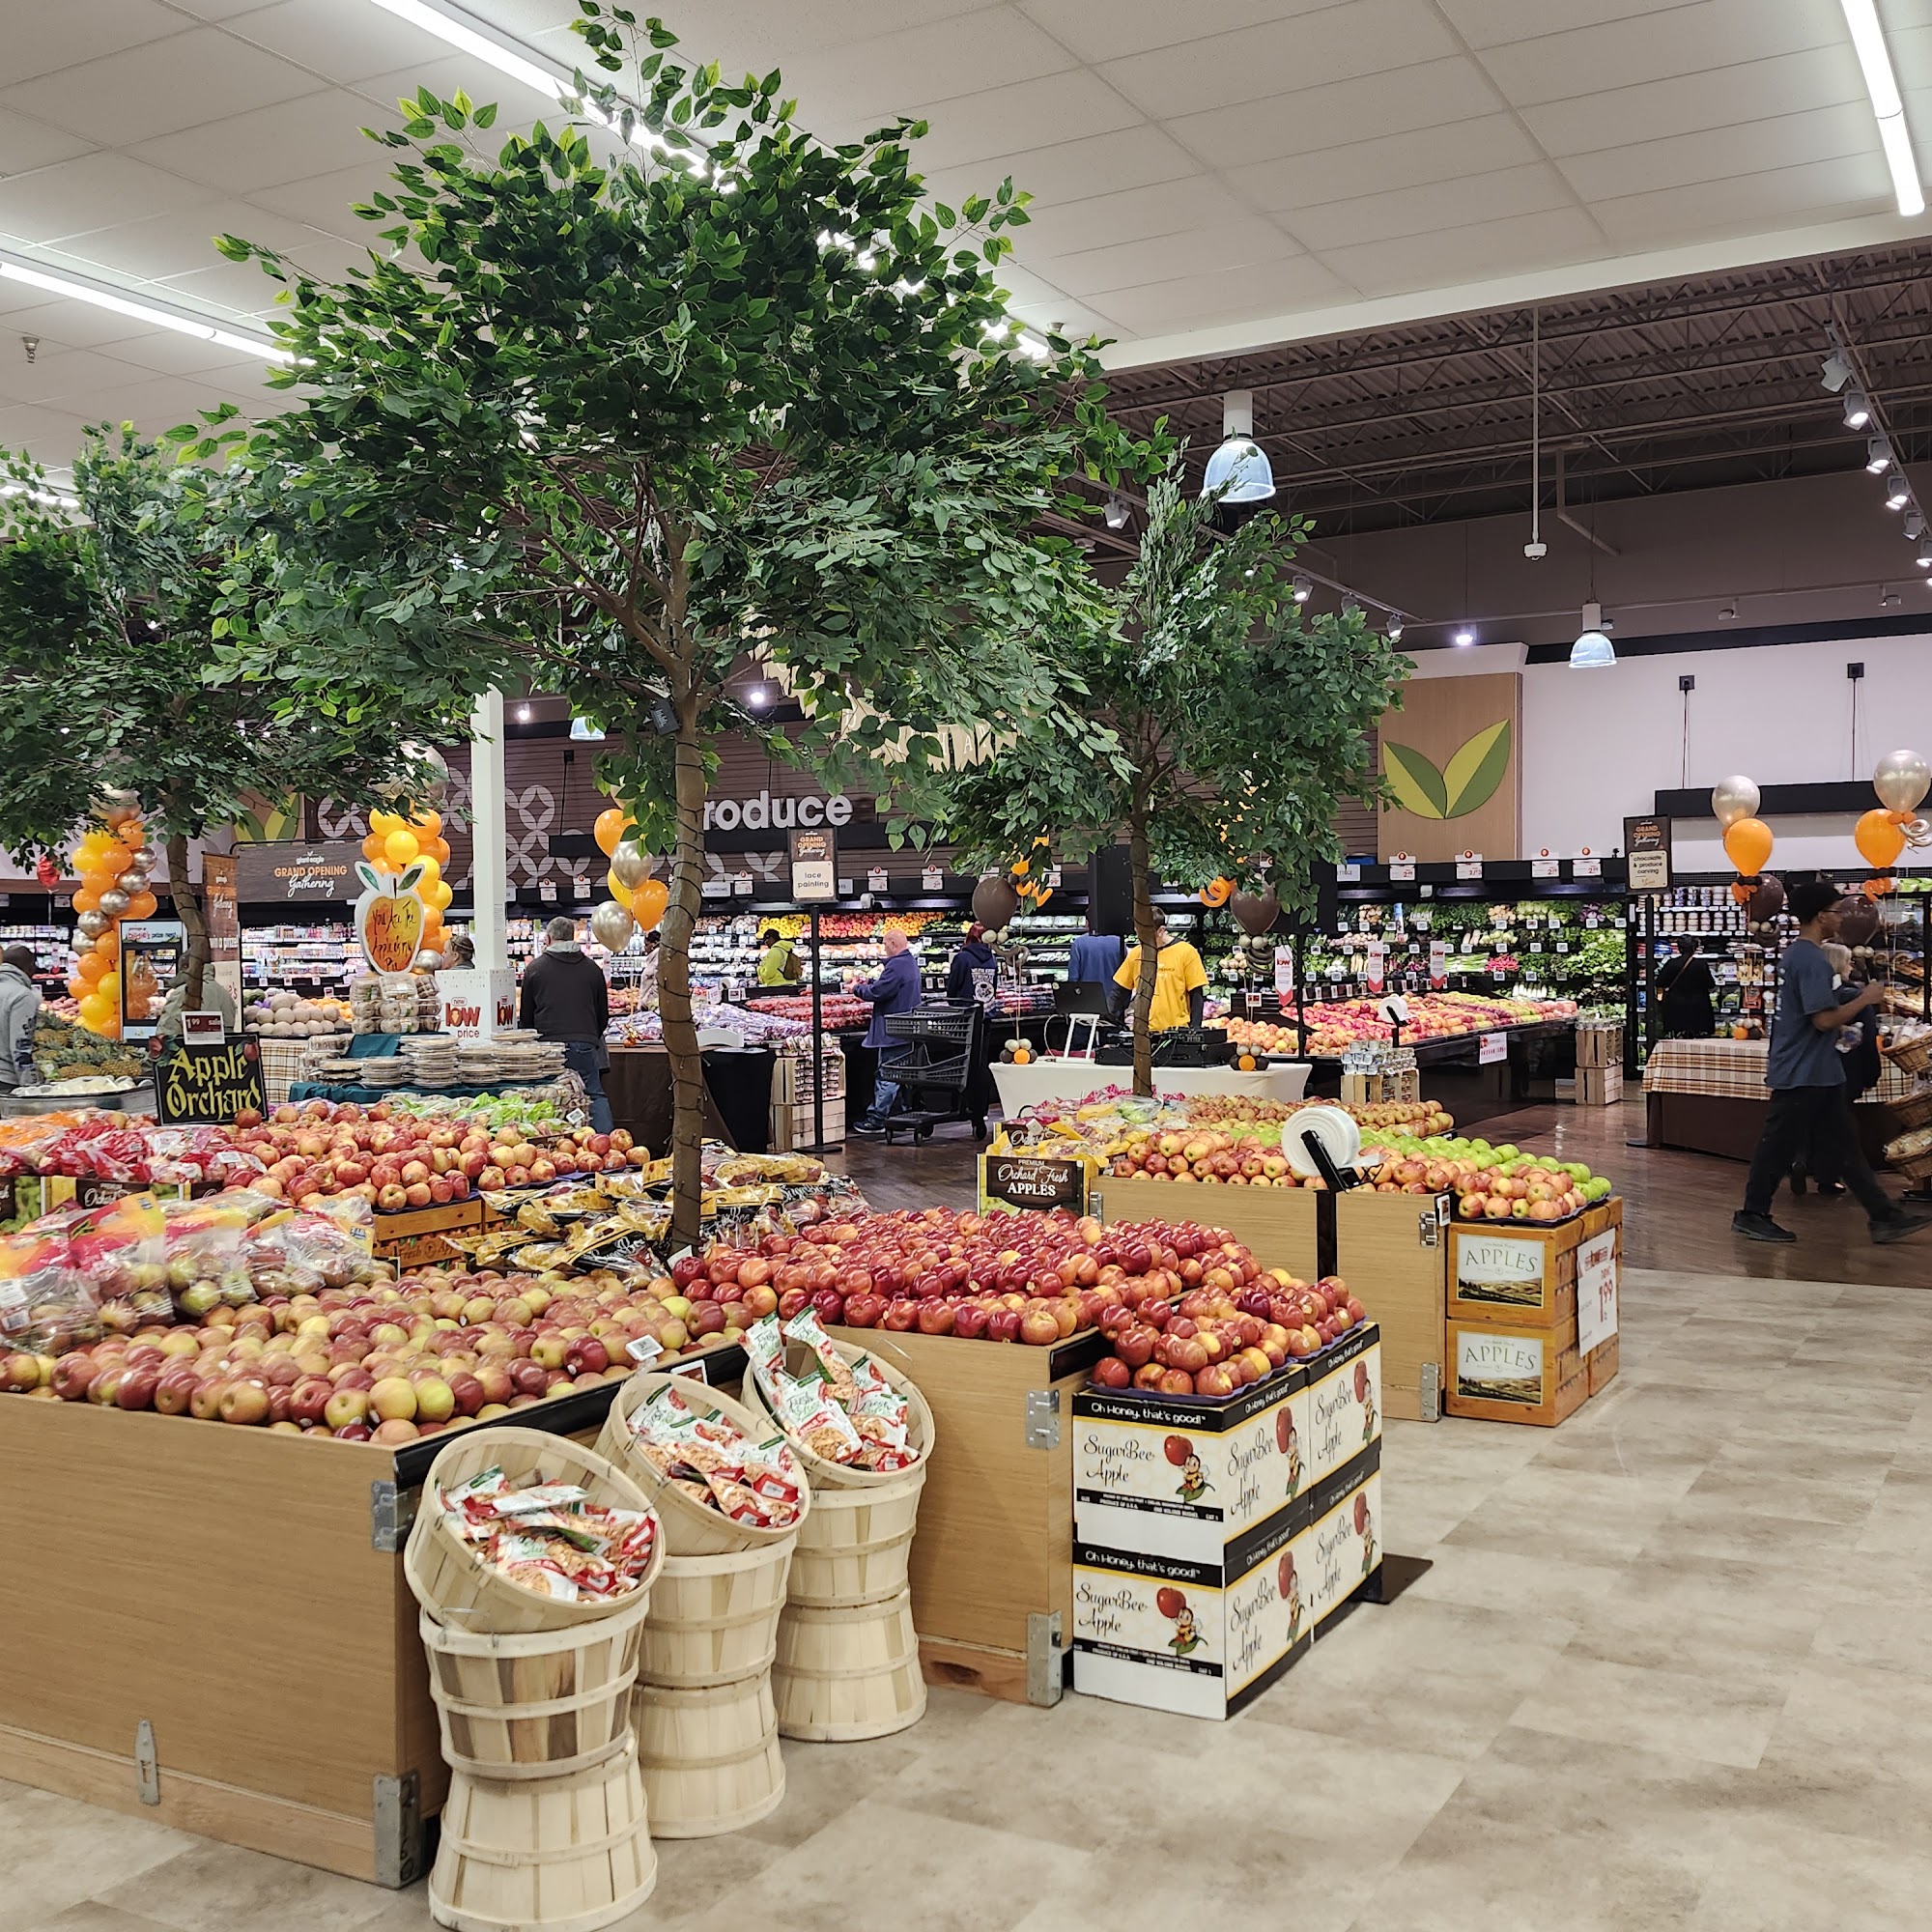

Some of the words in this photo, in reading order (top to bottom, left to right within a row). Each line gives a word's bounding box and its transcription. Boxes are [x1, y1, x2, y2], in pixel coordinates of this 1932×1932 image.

[703, 790, 853, 831] roduce
[274, 867, 306, 878] GRAND
[307, 866, 348, 876] OPENING
[287, 874, 335, 898] Gathering
[797, 880, 830, 889] painting
[445, 1003, 481, 1027] low
[497, 1001, 514, 1026] low
[457, 1028, 480, 1039] price
[167, 1045, 248, 1087] Apple
[166, 1076, 262, 1121] Orchard
[998, 1163, 1038, 1181] Orchard
[1038, 1165, 1069, 1184] Fresh
[1007, 1182, 1057, 1197] APPLES
[1465, 1248, 1538, 1273] APPLES
[1465, 1346, 1537, 1371] APPLES
[1091, 1402, 1106, 1413] Oh
[1107, 1406, 1141, 1419] Honey,
[1143, 1407, 1171, 1421] that's
[1315, 1379, 1352, 1435] SugarBee
[1084, 1435, 1155, 1464] SugarBee
[1228, 1428, 1274, 1481] SugarBee
[1318, 1422, 1342, 1463] Apple
[1086, 1460, 1129, 1488] Apple
[1231, 1474, 1261, 1519] Apple
[1316, 1515, 1352, 1566] SugarBee
[1085, 1550, 1100, 1562] Oh
[1101, 1555, 1135, 1570] Honey,
[1137, 1559, 1165, 1573] that's
[1318, 1558, 1342, 1602] Apple
[1076, 1582, 1148, 1612] SugarBee
[1231, 1577, 1276, 1633] SugarBee
[1078, 1608, 1122, 1637] Apple
[1233, 1625, 1262, 1671] Apple
